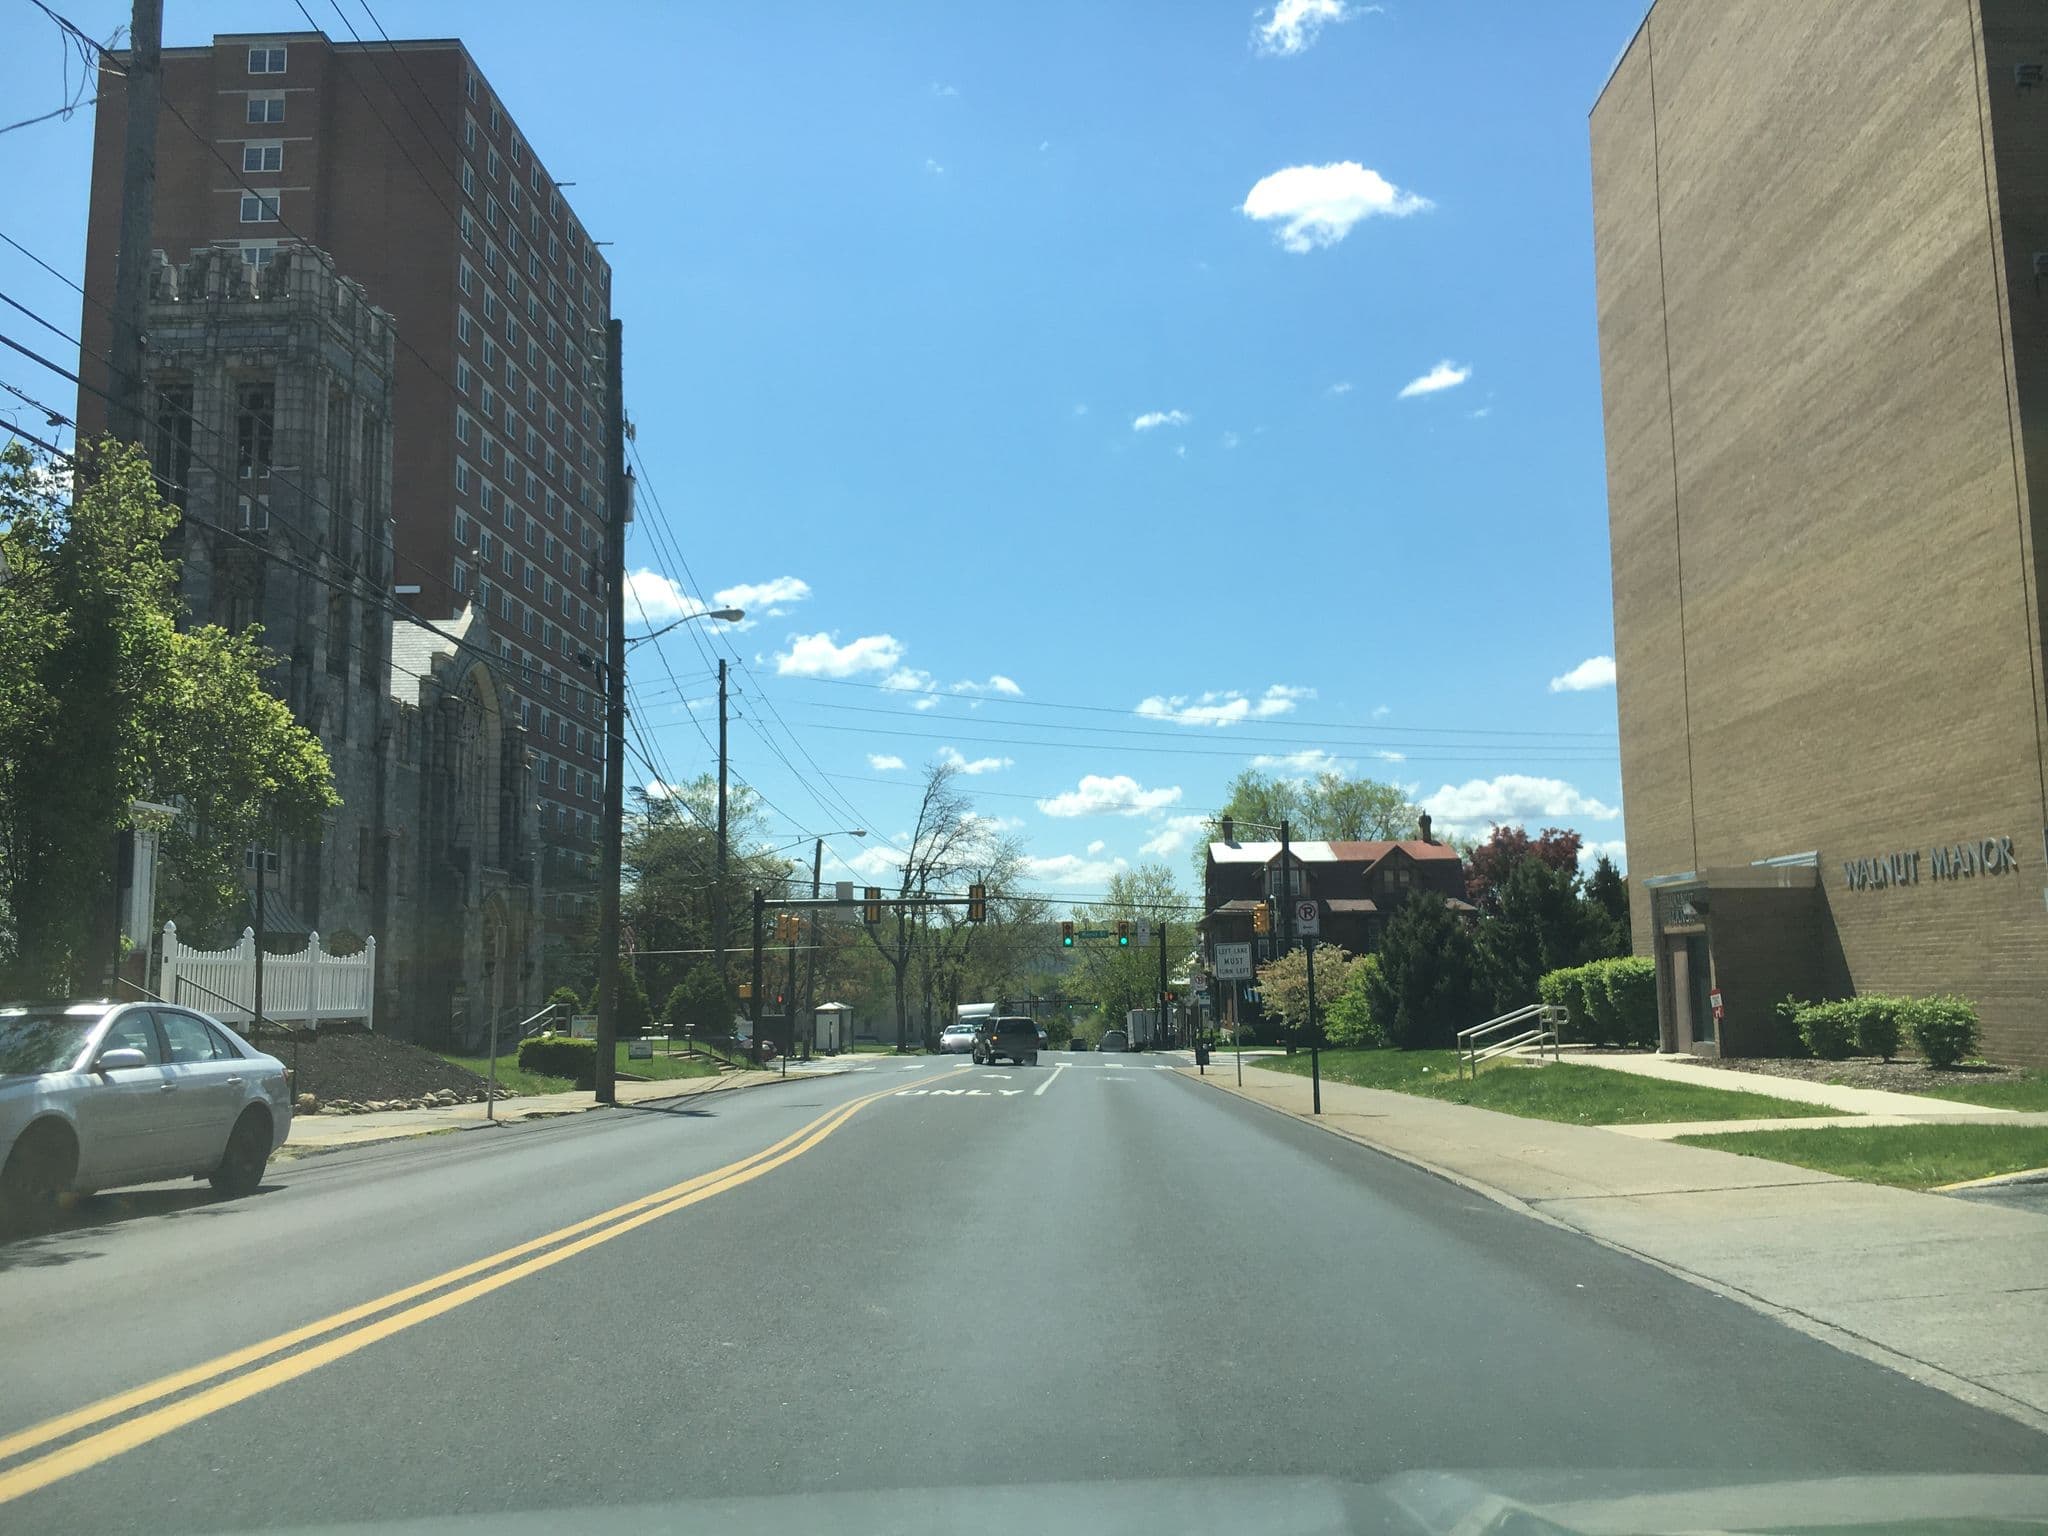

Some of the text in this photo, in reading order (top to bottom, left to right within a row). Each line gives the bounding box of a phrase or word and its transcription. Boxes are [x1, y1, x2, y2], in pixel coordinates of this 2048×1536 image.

[1844, 835, 2018, 889] WALNUT MANOR
[1224, 957, 1243, 965] MUST
